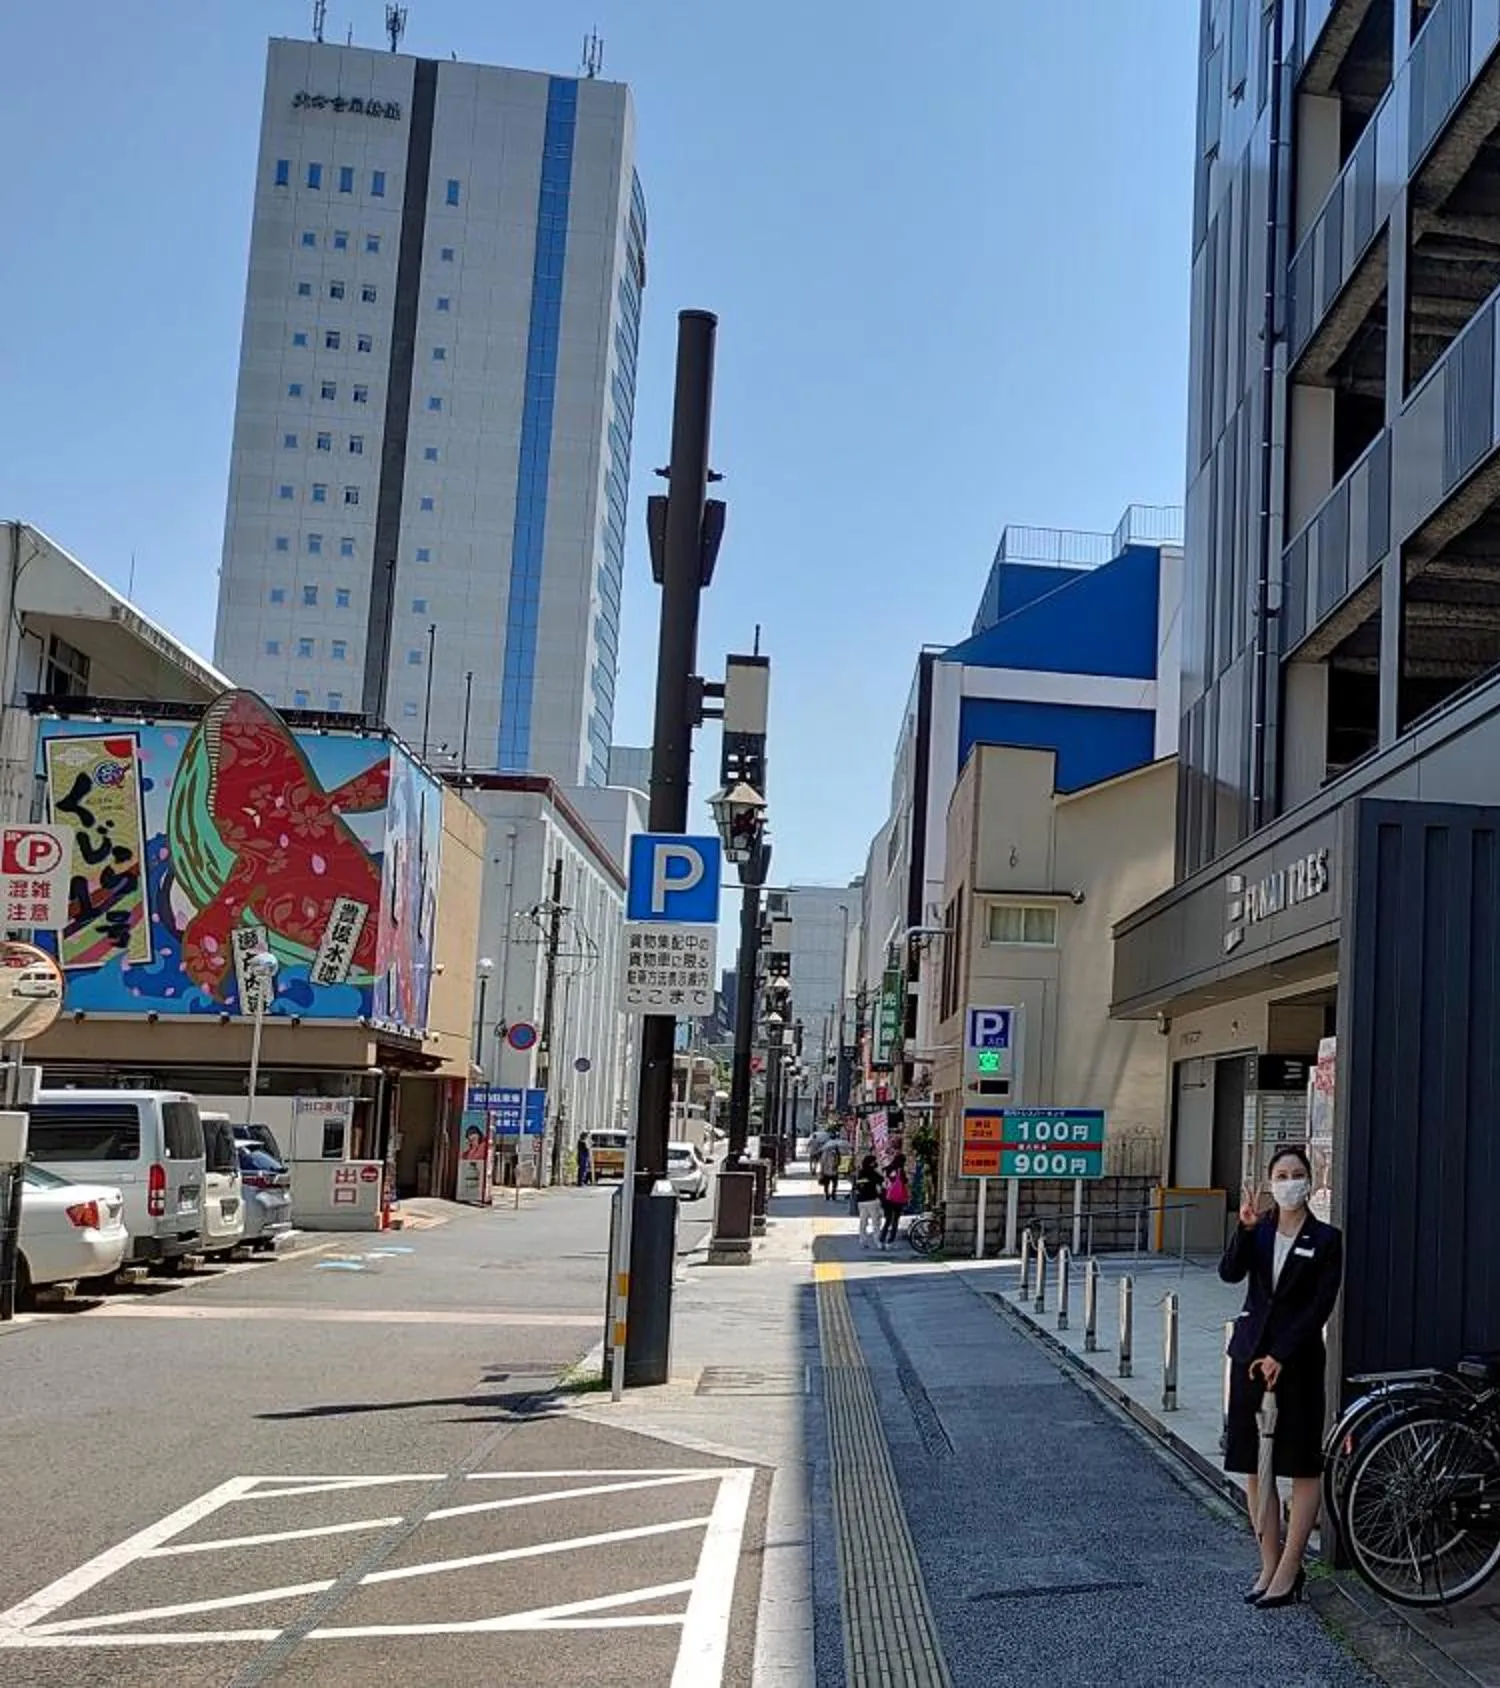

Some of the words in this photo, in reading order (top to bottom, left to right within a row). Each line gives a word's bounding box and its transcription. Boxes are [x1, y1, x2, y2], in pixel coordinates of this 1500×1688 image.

[28, 841, 52, 867] P
[651, 843, 705, 913] P
[1288, 847, 1327, 905] TRES
[8, 880, 51, 899] 混雑
[8, 903, 50, 921] 注意
[630, 933, 710, 950] 貨物集配中の
[629, 951, 709, 969] 貨物車に限る
[627, 988, 707, 1005] ここまで
[975, 1012, 1004, 1047] P
[978, 1050, 1000, 1072] 空
[1018, 1121, 1089, 1141] 100円
[1014, 1153, 1087, 1174] 900円
[334, 1168, 357, 1204] 出口
